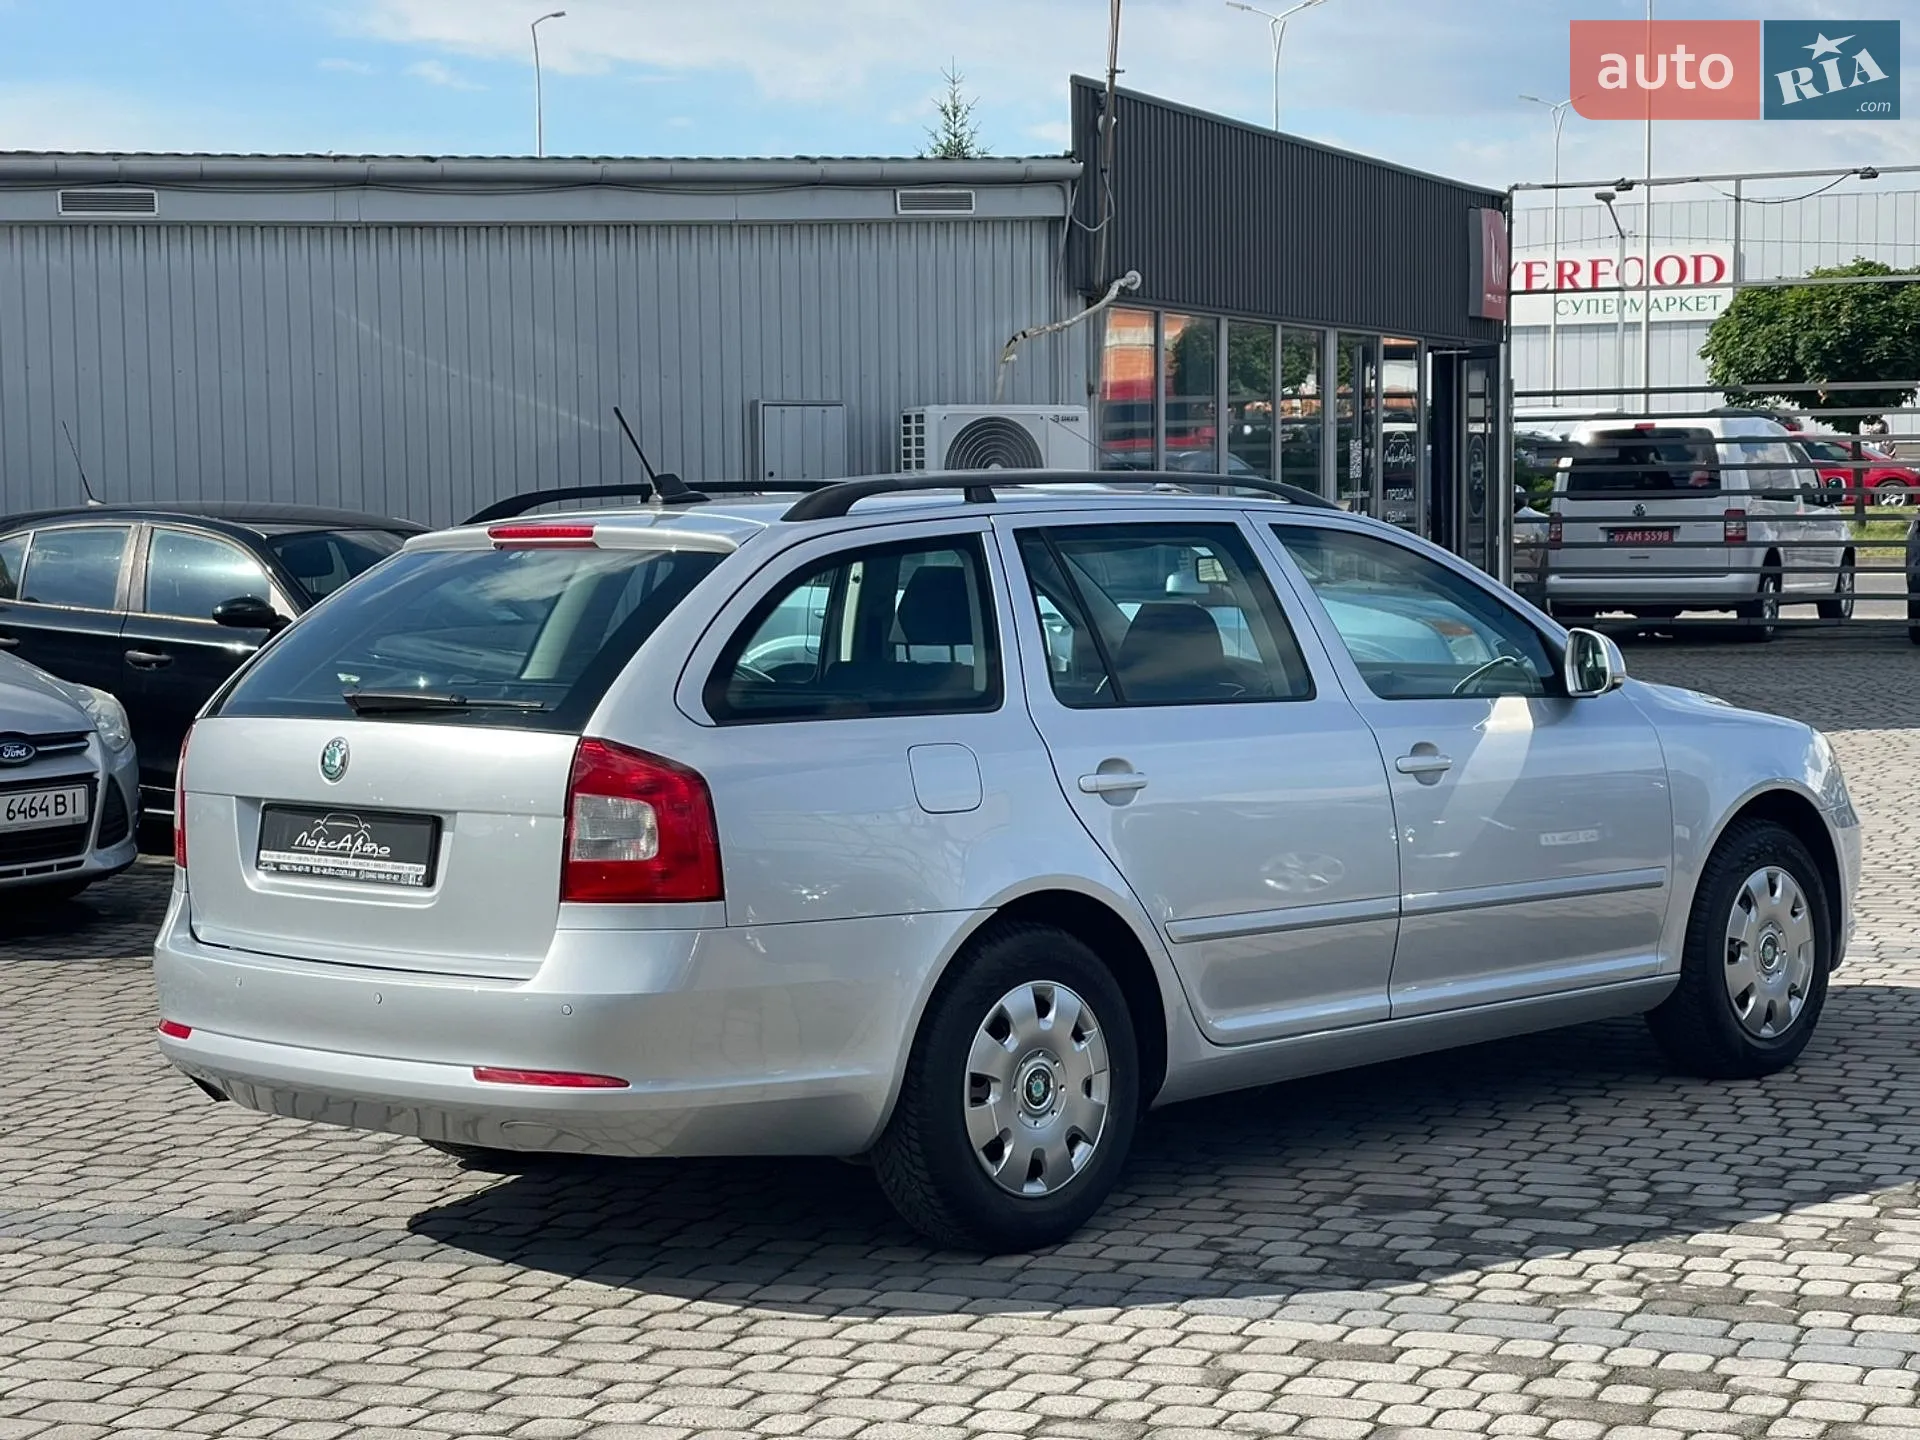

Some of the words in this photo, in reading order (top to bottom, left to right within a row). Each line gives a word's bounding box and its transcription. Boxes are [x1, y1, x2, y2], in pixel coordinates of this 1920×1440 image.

[1625, 531, 1642, 541] AM
[2, 745, 27, 758] Ford
[6, 795, 50, 821] 6464
